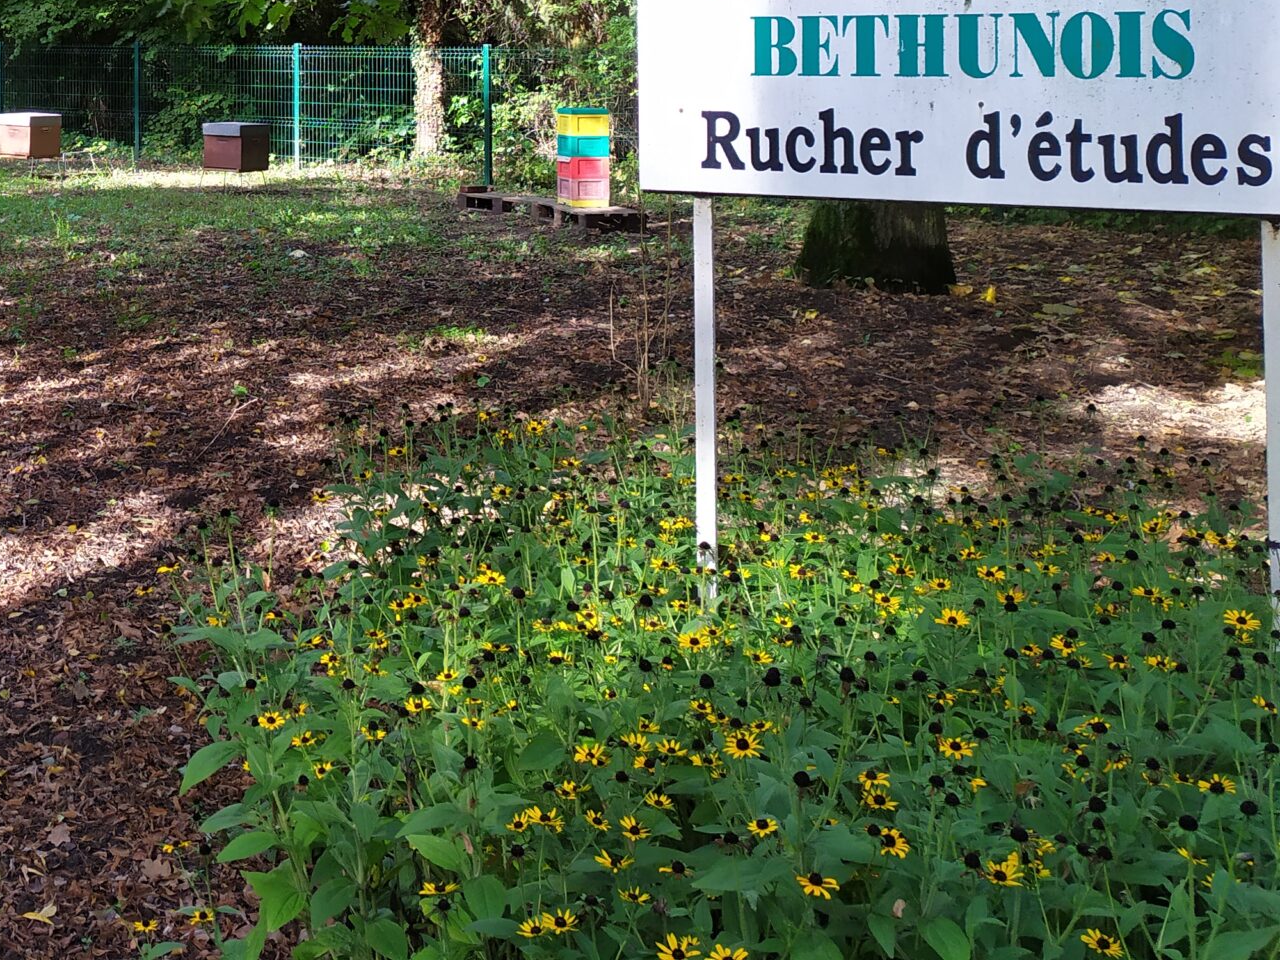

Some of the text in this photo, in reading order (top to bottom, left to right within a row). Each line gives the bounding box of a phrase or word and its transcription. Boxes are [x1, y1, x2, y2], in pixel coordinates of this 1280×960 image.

[750, 8, 1195, 79] BETHUNOIS
[701, 107, 1273, 187] Rucher d'études
